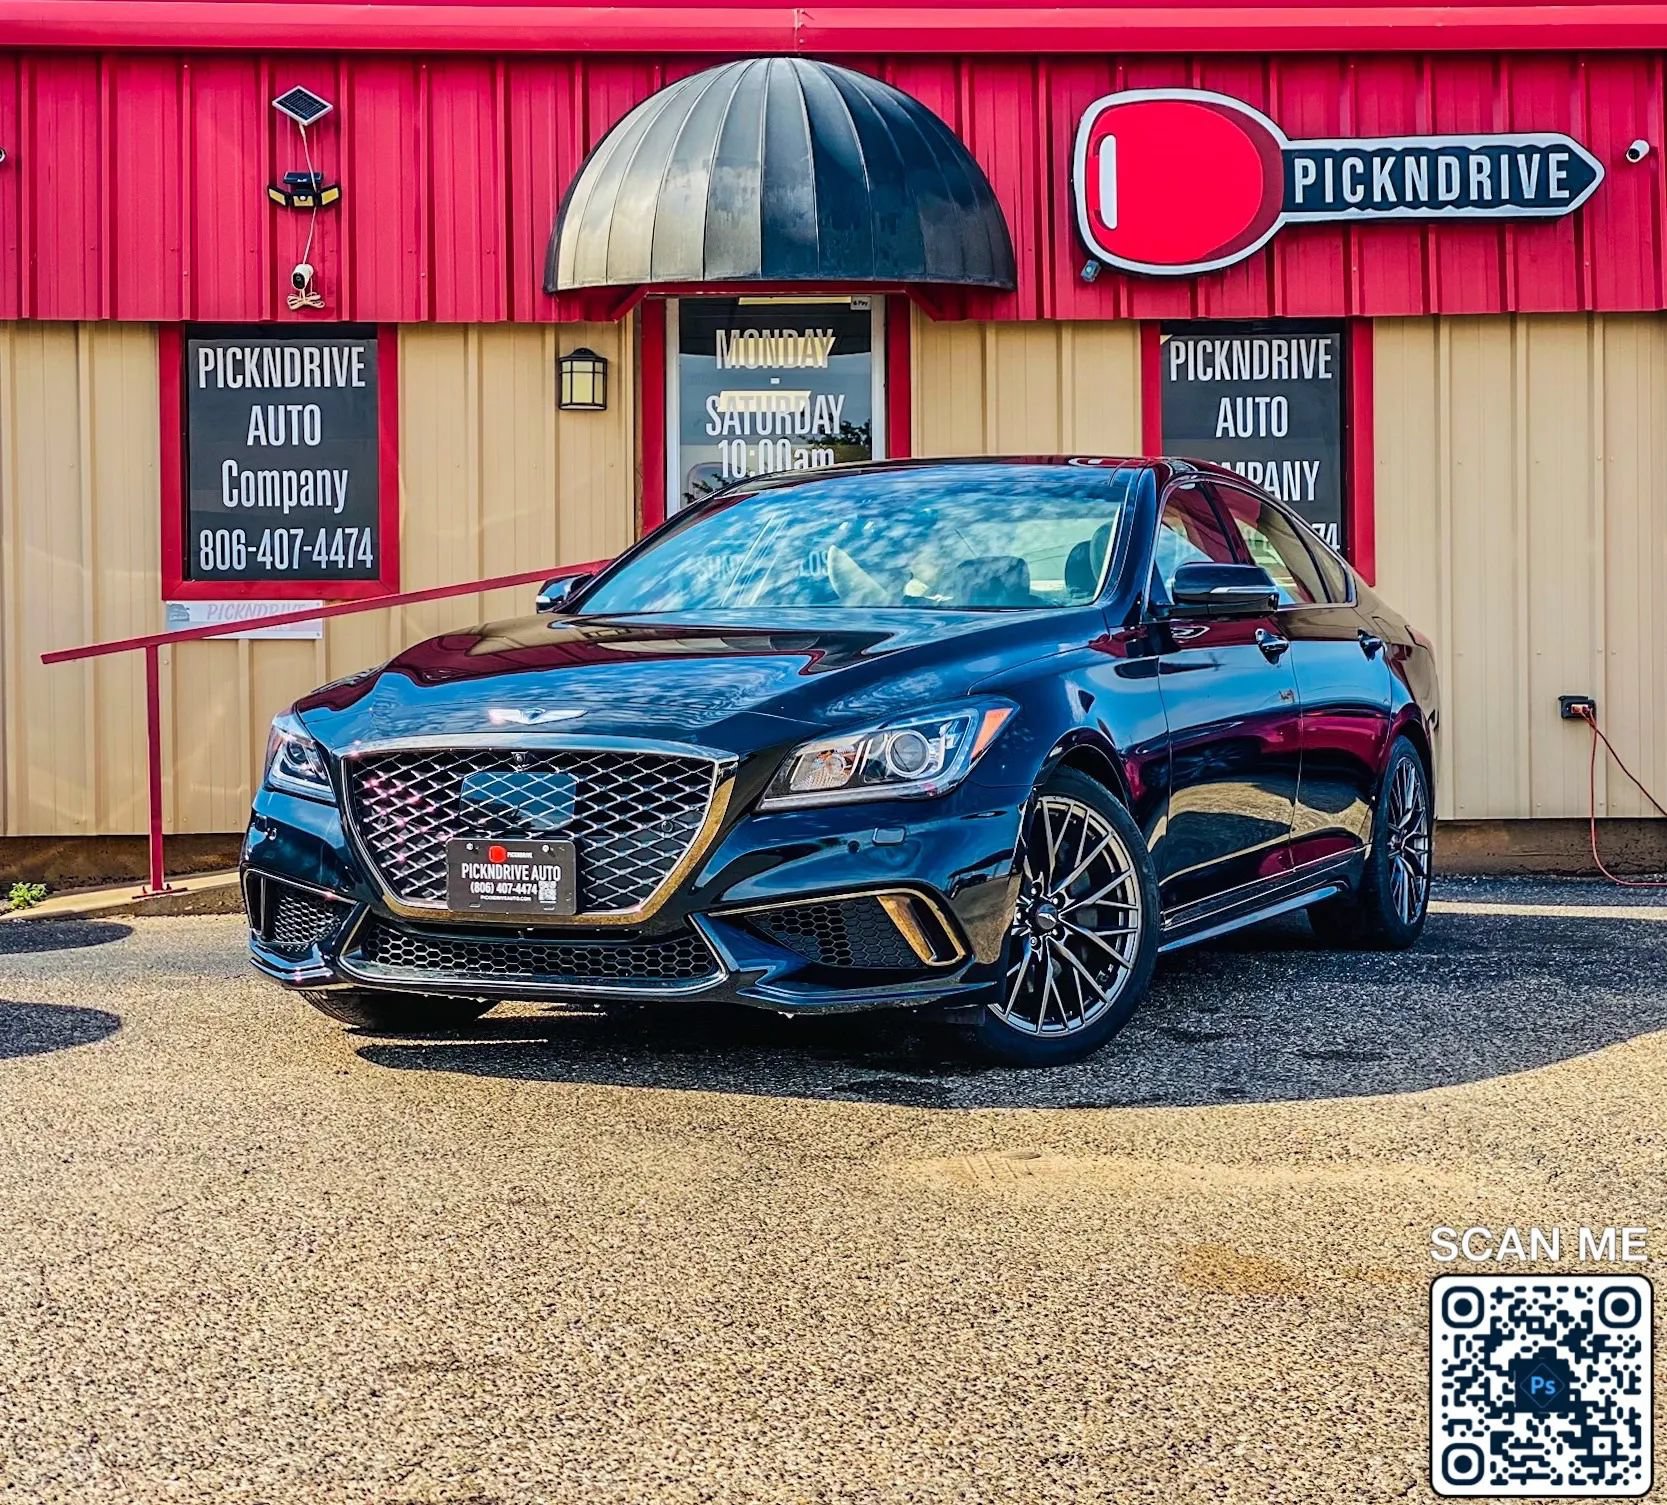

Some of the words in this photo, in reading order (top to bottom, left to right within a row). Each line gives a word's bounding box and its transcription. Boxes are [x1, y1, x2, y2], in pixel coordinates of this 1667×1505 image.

[1294, 152, 1570, 204] PICKNDRIVE
[198, 346, 366, 389] PICKNDRIVE
[715, 328, 834, 370] MONDAY
[1169, 338, 1333, 382] PICKNDRIVE
[246, 403, 322, 447] AUTO
[705, 394, 846, 436] SATURDAY
[1215, 395, 1289, 438] AUTO
[717, 438, 834, 479] 10:00am
[221, 459, 349, 514] Company
[1208, 460, 1321, 502] PANY
[200, 527, 374, 571] 806-407-4474
[461, 862, 529, 881] PICKNDRIVE
[531, 864, 561, 882] AUTO
[470, 881, 495, 894] (806)
[496, 882, 538, 895] 407-4474
